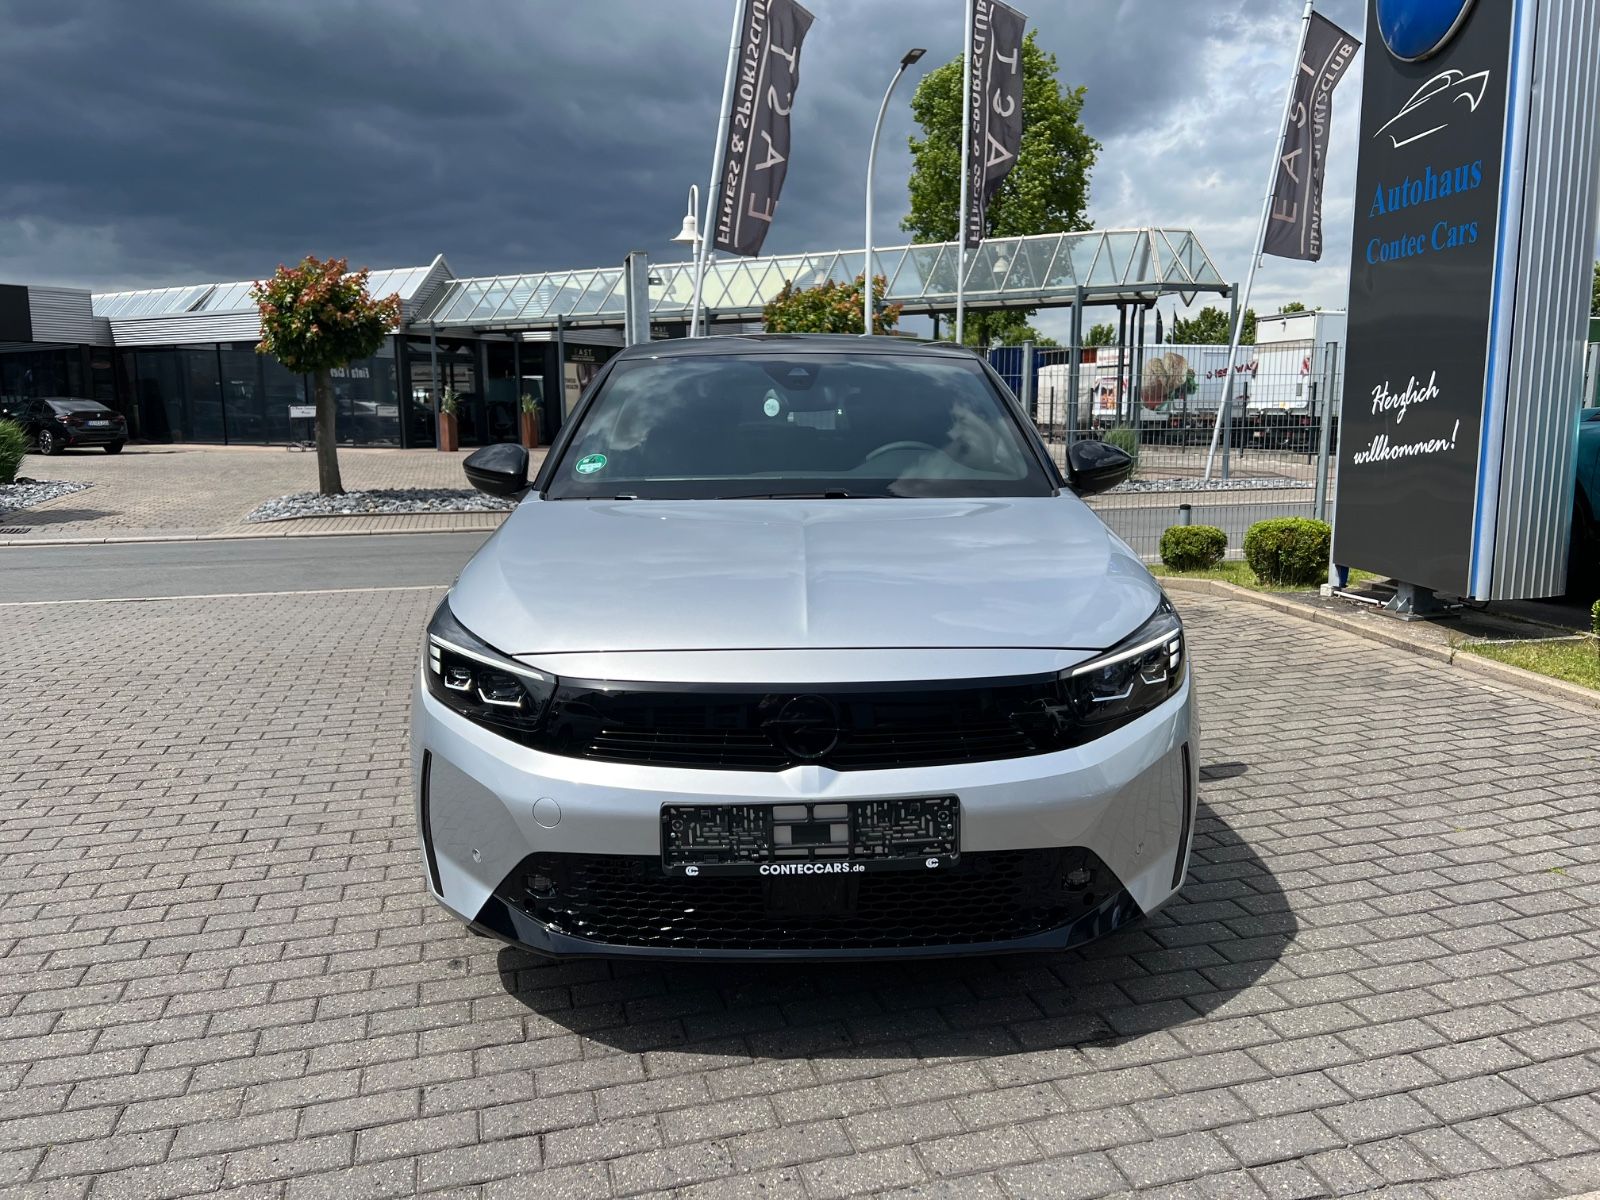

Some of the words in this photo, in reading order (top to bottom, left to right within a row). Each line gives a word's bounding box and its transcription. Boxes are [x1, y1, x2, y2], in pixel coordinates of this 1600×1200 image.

[1313, 43, 1353, 161] SORTSCLUB
[1369, 159, 1482, 218] Autohaus
[1366, 234, 1426, 264] Contec
[1431, 220, 1478, 250] Cars
[1372, 370, 1440, 424] Herzlich
[1354, 419, 1460, 464] willkommen!
[760, 862, 865, 875] CONTECCARS.de
